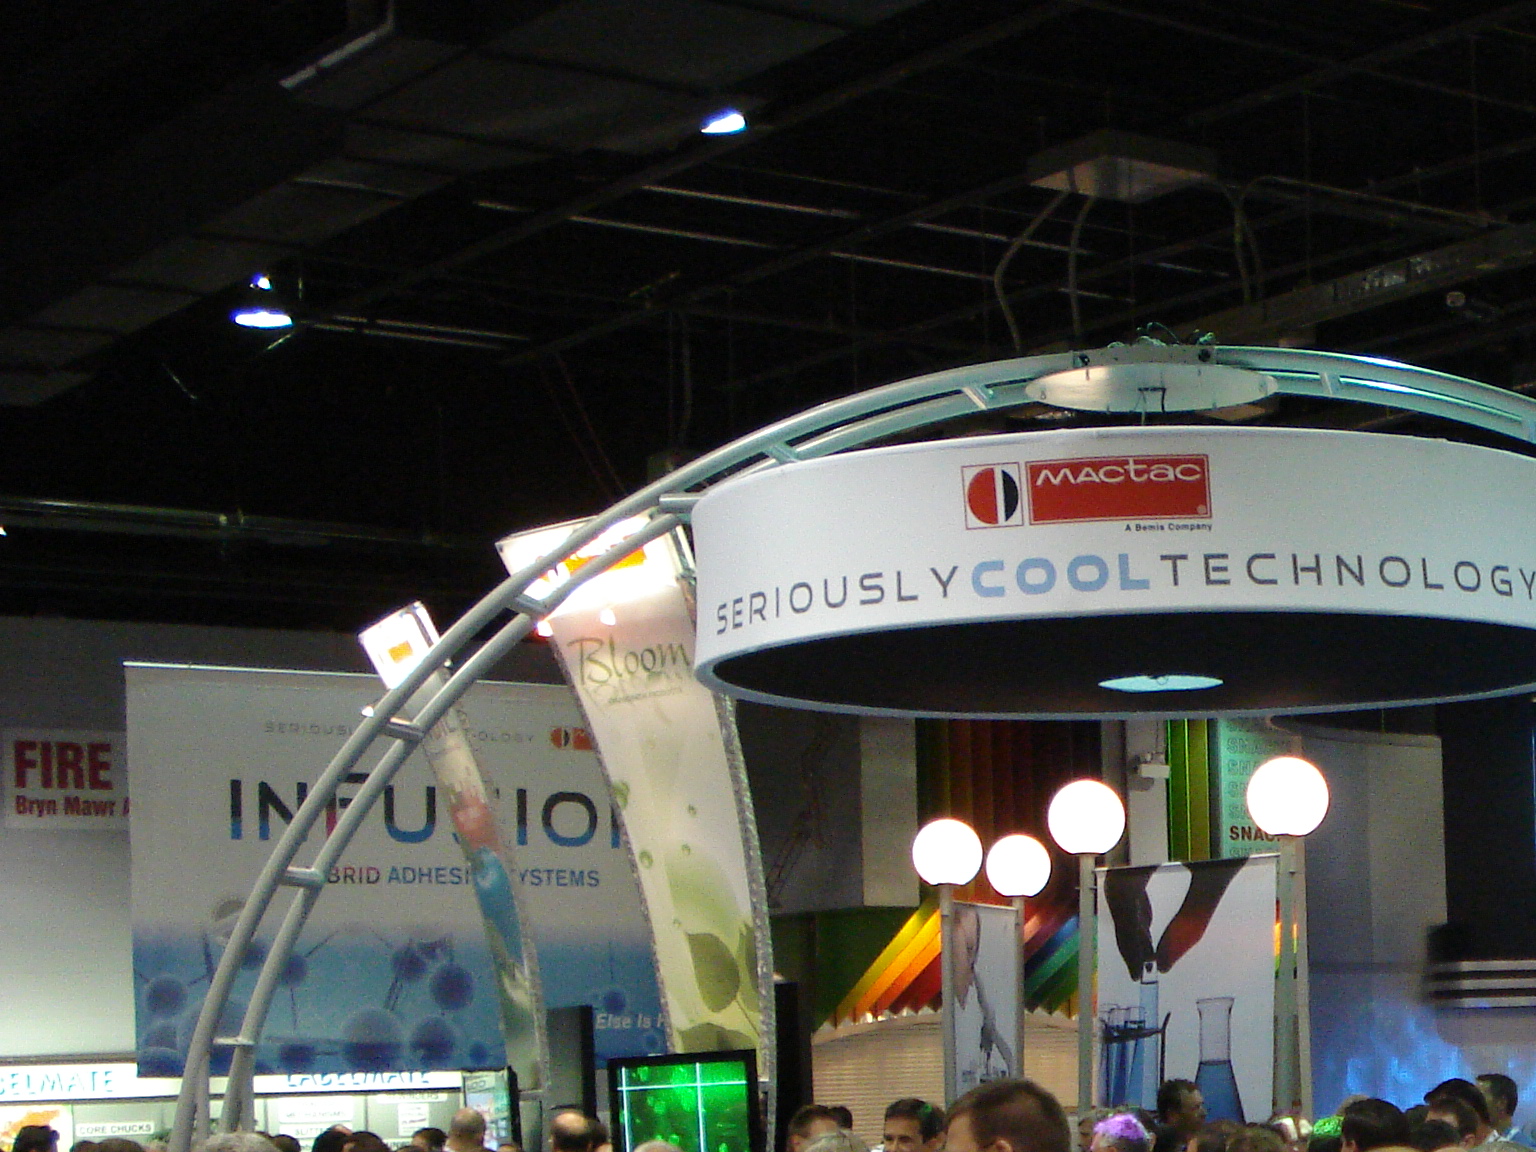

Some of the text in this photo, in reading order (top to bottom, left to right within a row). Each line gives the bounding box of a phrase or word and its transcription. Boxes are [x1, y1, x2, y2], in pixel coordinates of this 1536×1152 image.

[1125, 523, 1212, 532] A Bemis Company
[567, 634, 691, 686] Bloom
[14, 740, 114, 790] FIRE
[230, 772, 620, 848] INFUIO
[327, 866, 600, 887] BRID ADHESI YSTEMS
[79, 1124, 152, 1134] CORE CHUCKS
